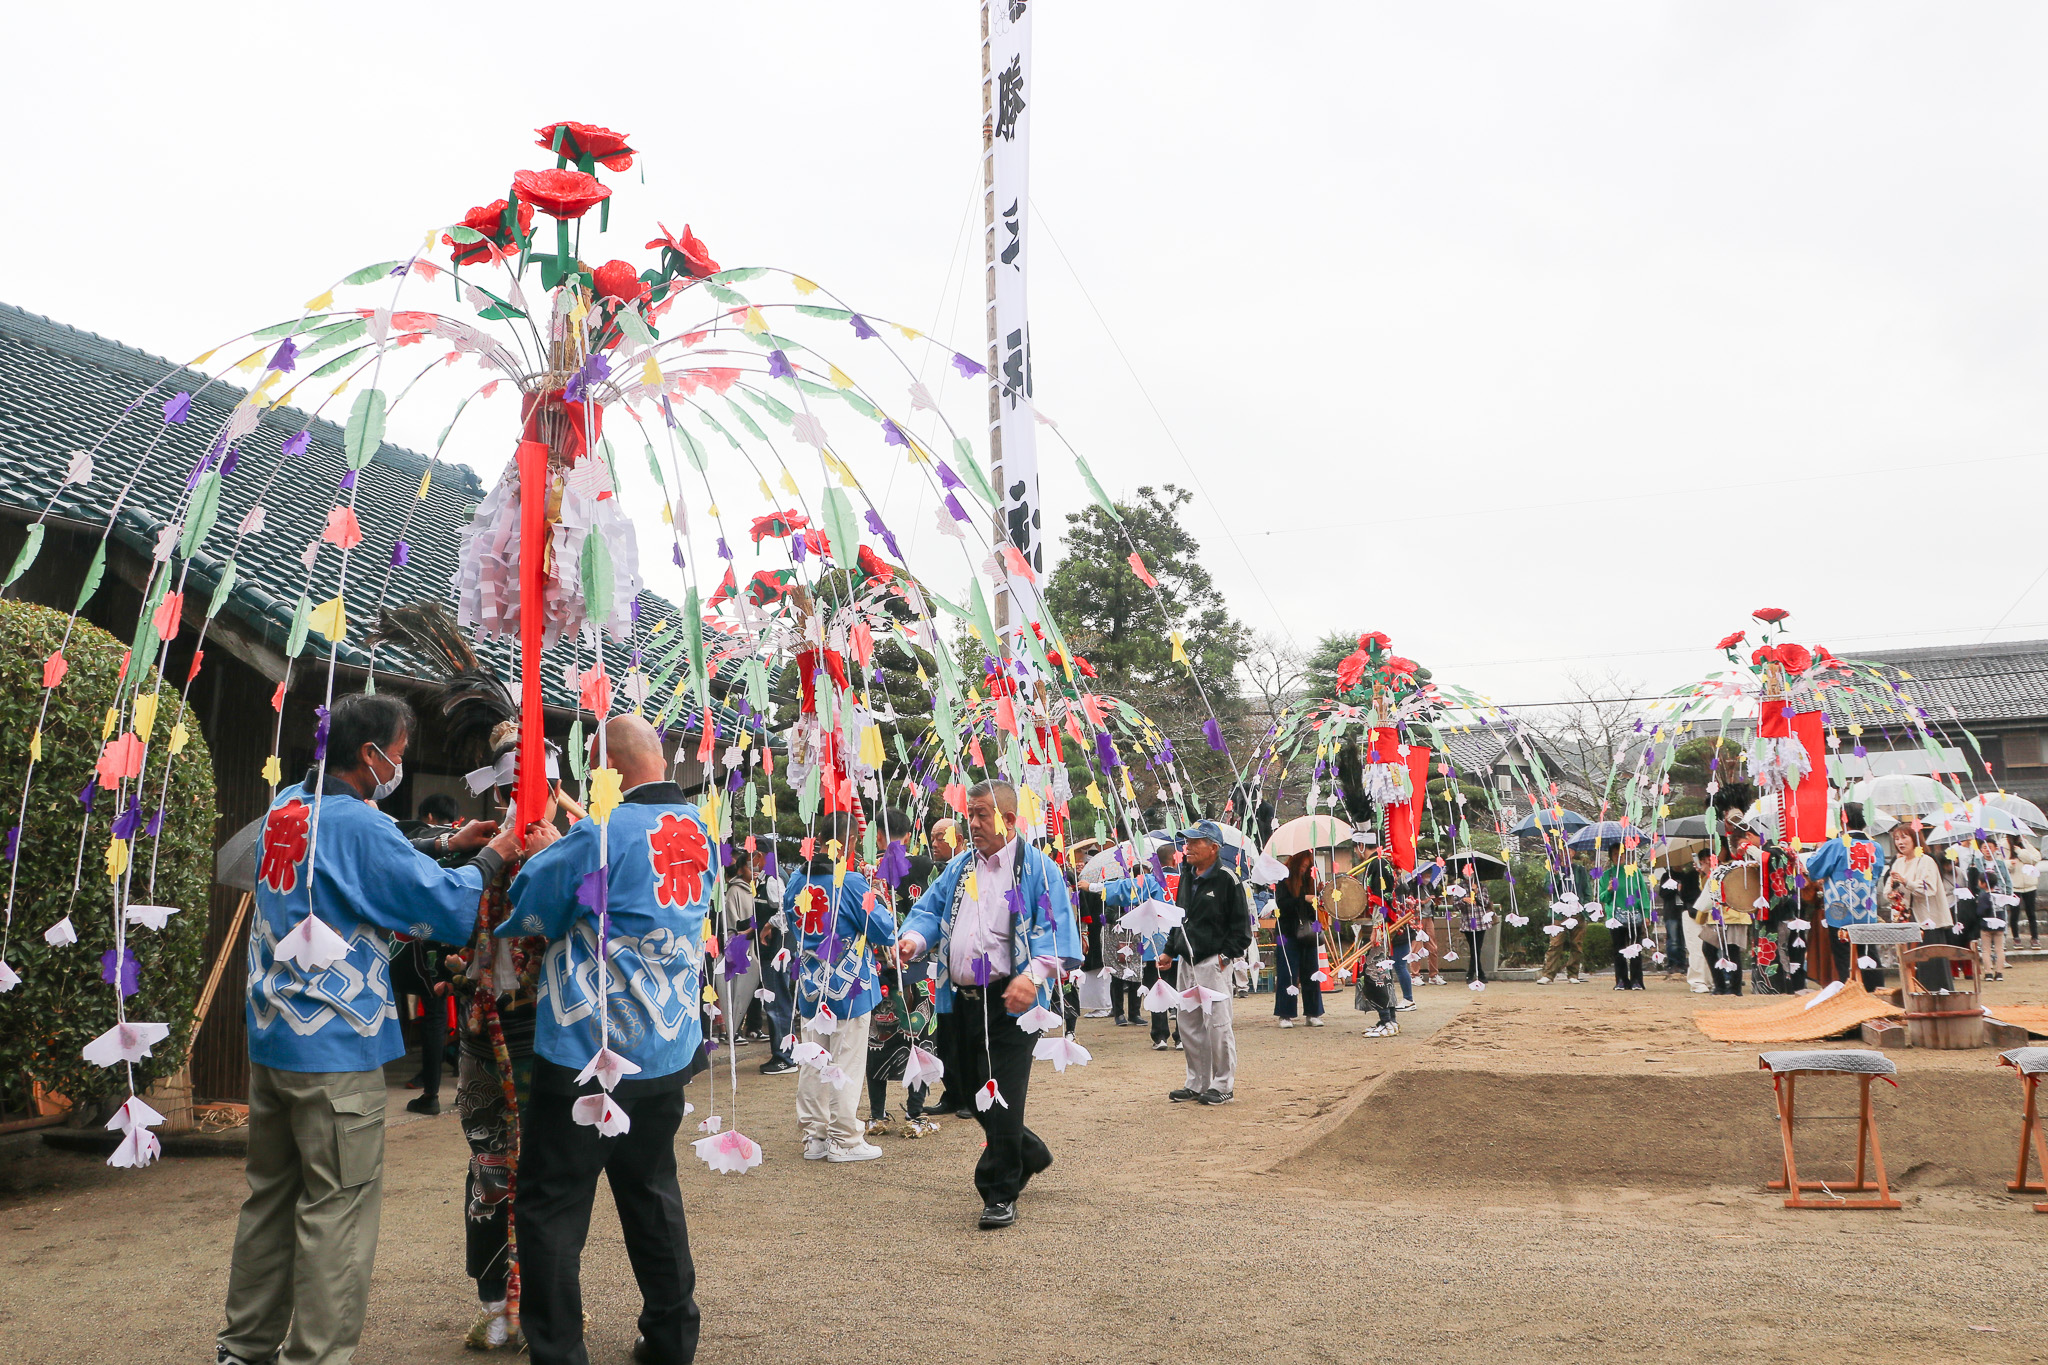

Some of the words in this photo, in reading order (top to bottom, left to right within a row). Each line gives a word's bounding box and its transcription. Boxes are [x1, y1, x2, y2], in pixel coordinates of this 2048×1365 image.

[258, 797, 311, 893] 祭
[648, 812, 709, 909] 祭
[1848, 841, 1877, 873] 祭
